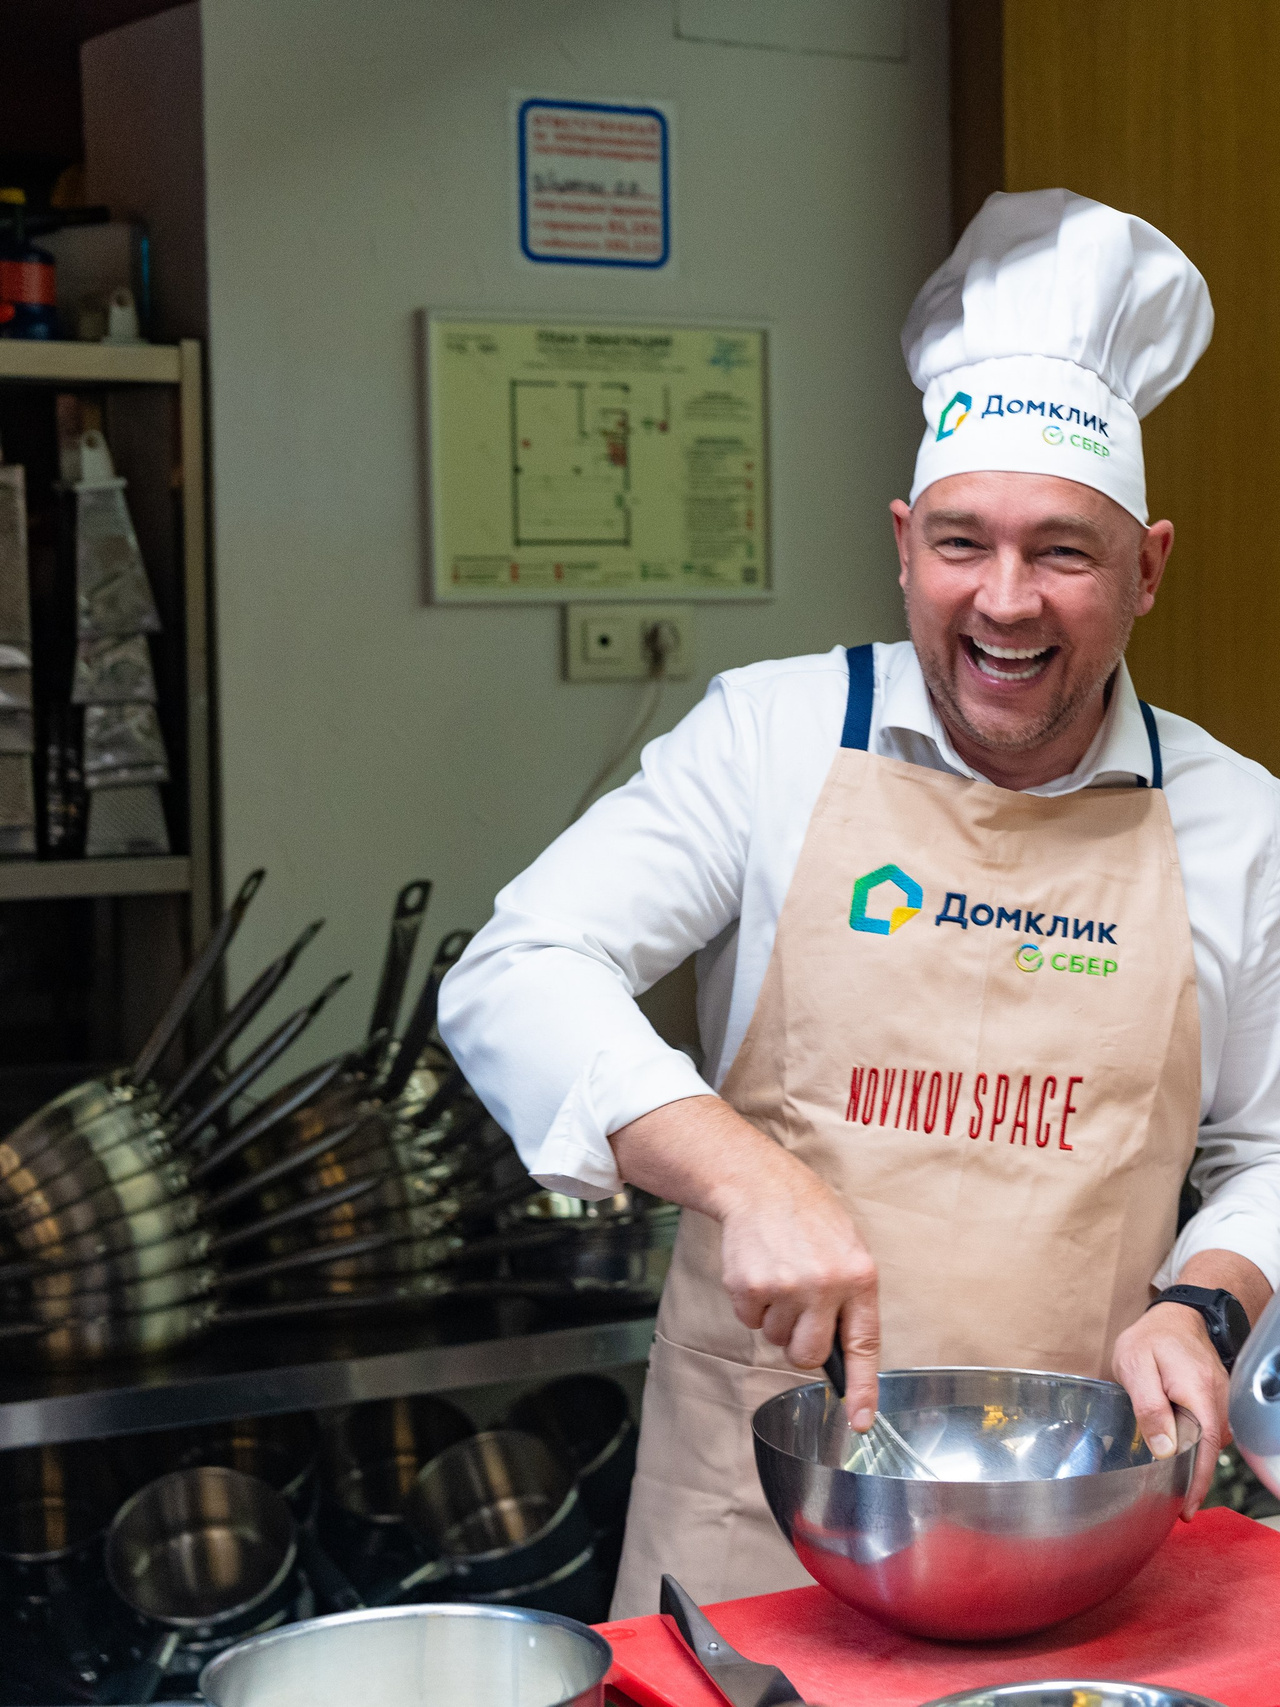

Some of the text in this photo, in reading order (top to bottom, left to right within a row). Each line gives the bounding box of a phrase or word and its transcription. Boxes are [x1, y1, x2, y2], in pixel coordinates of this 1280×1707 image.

[1069, 434, 1110, 459] СБЕР
[1049, 952, 1119, 978] СБЕР
[845, 1066, 1084, 1151] NOVIKOV SPACE
